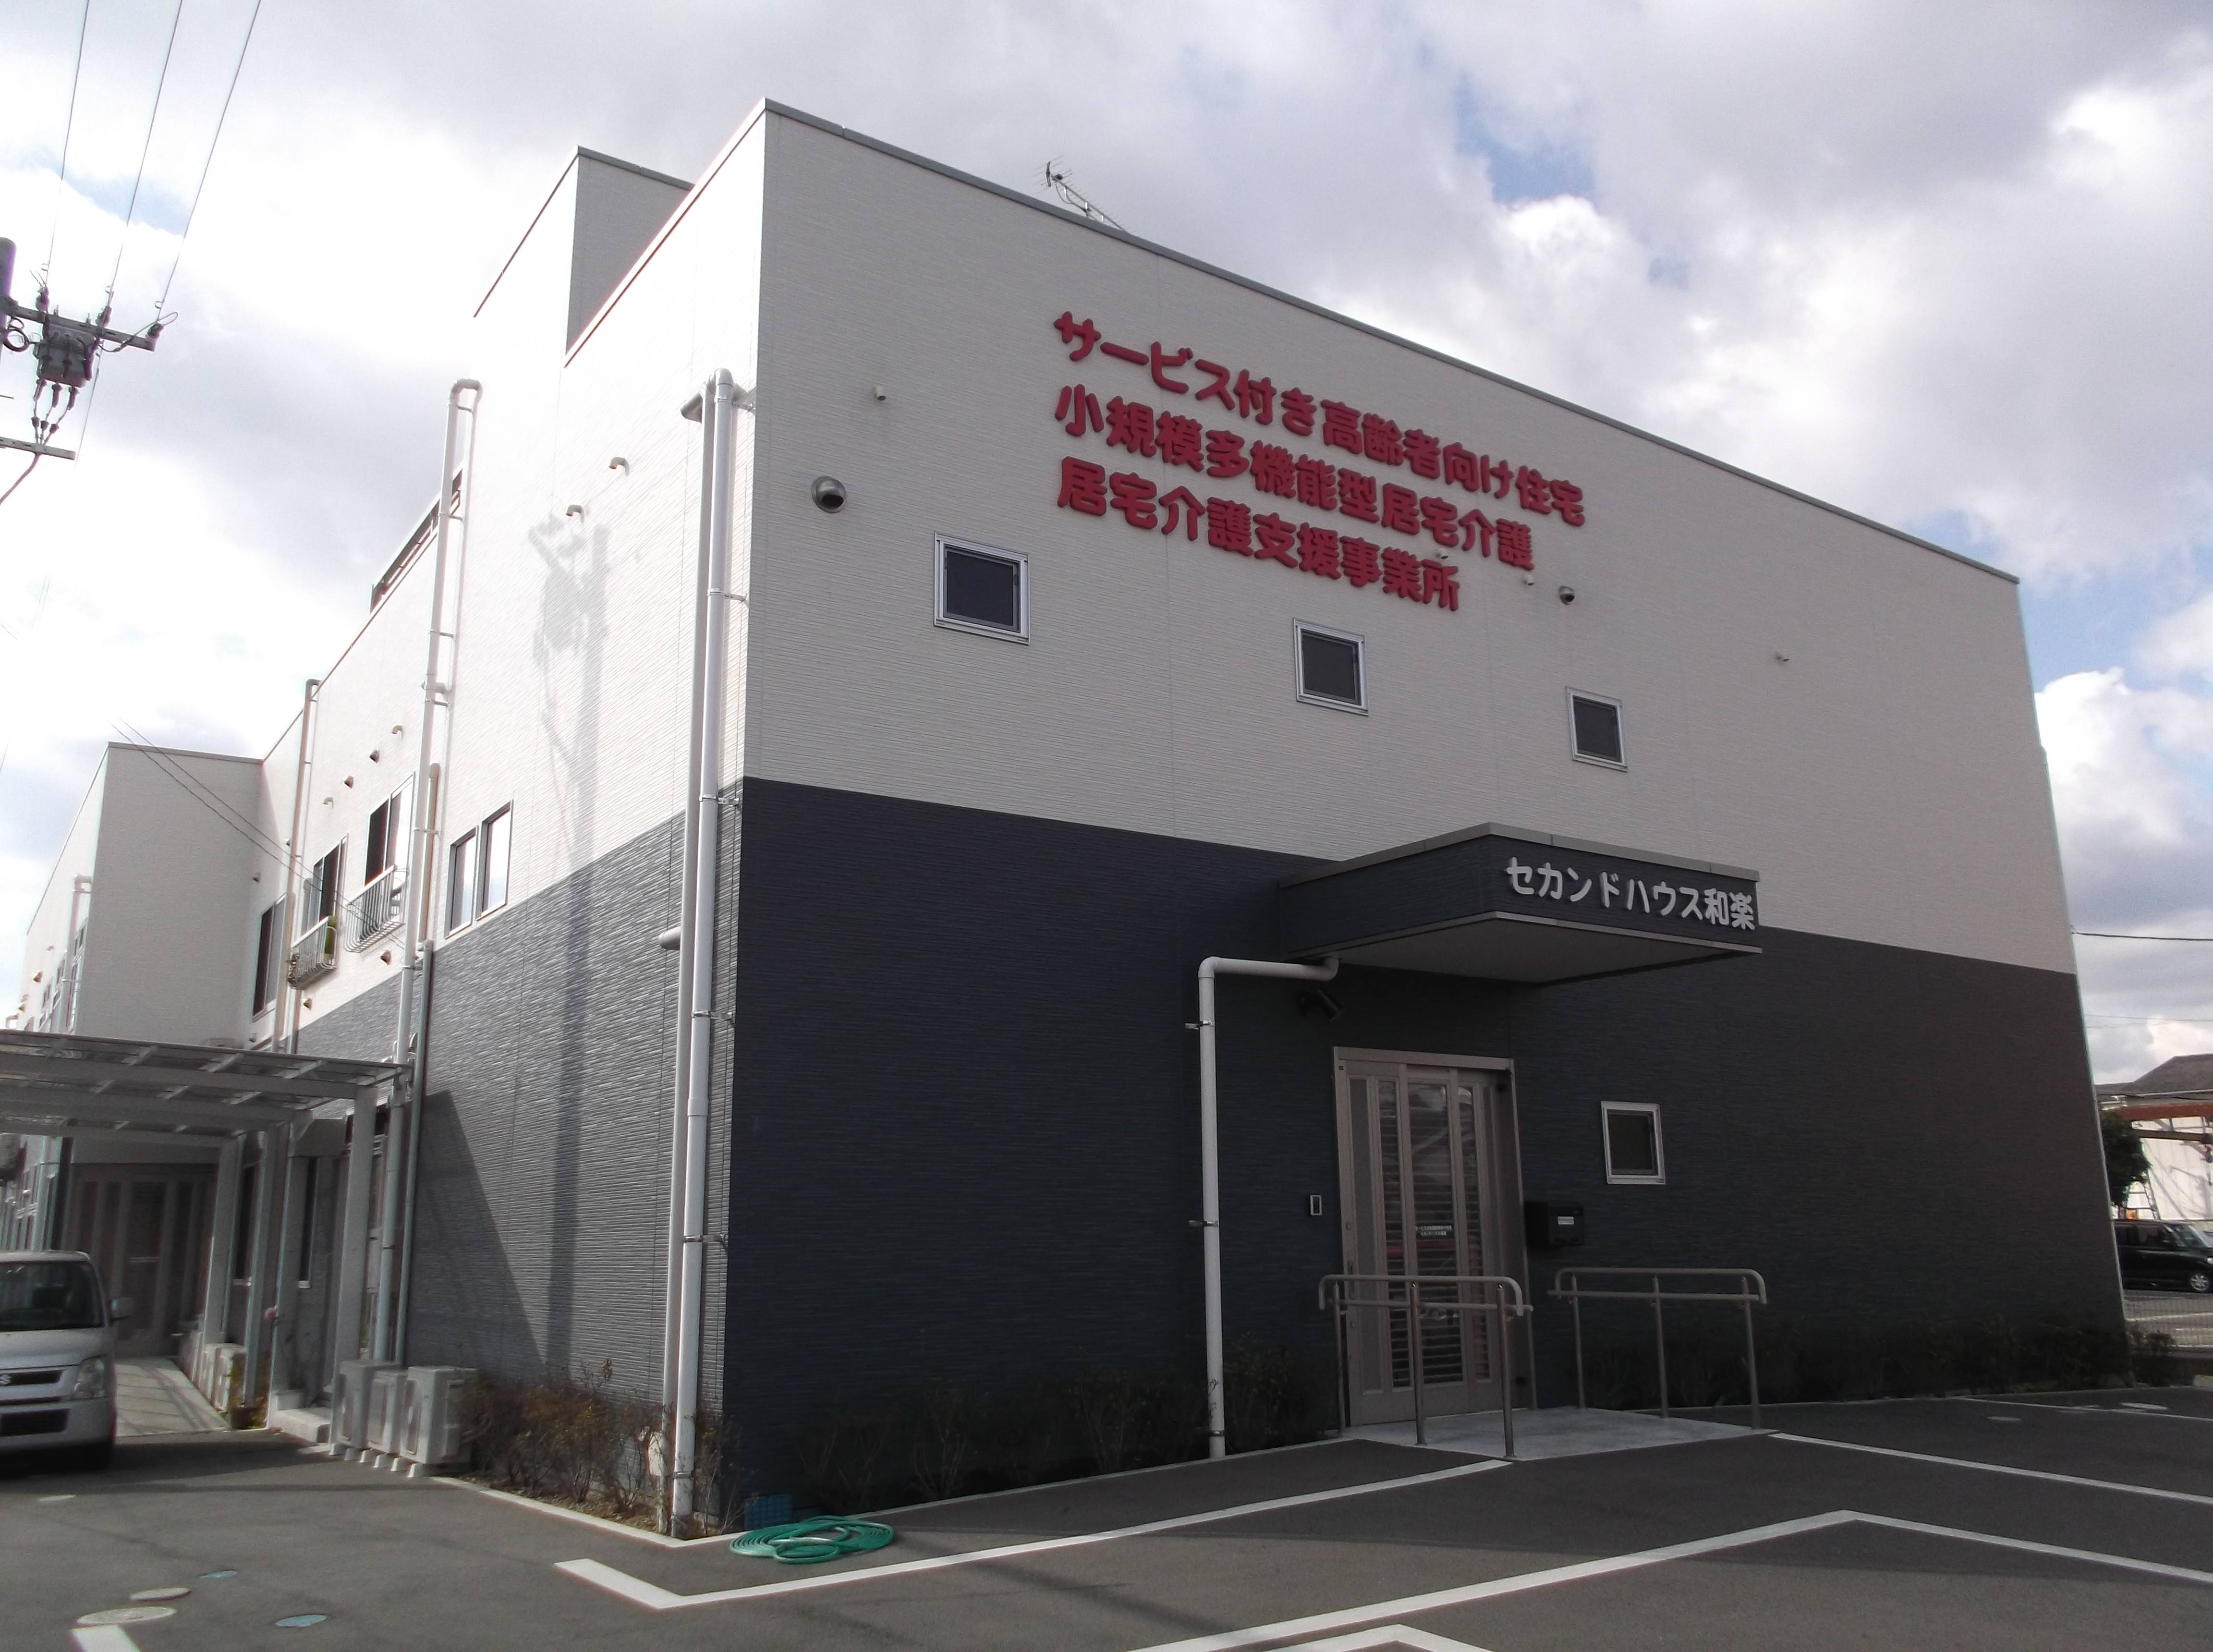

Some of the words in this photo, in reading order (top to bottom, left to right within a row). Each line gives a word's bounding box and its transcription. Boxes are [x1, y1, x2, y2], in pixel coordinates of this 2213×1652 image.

[1054, 311, 1584, 526] サービス付き高齢者向け住宅
[1055, 384, 1534, 571] 小規模多機能型居宅介護
[1057, 456, 1459, 611] 居宅介護支援事業所
[1505, 857, 1756, 930] セカンドハウス和楽
